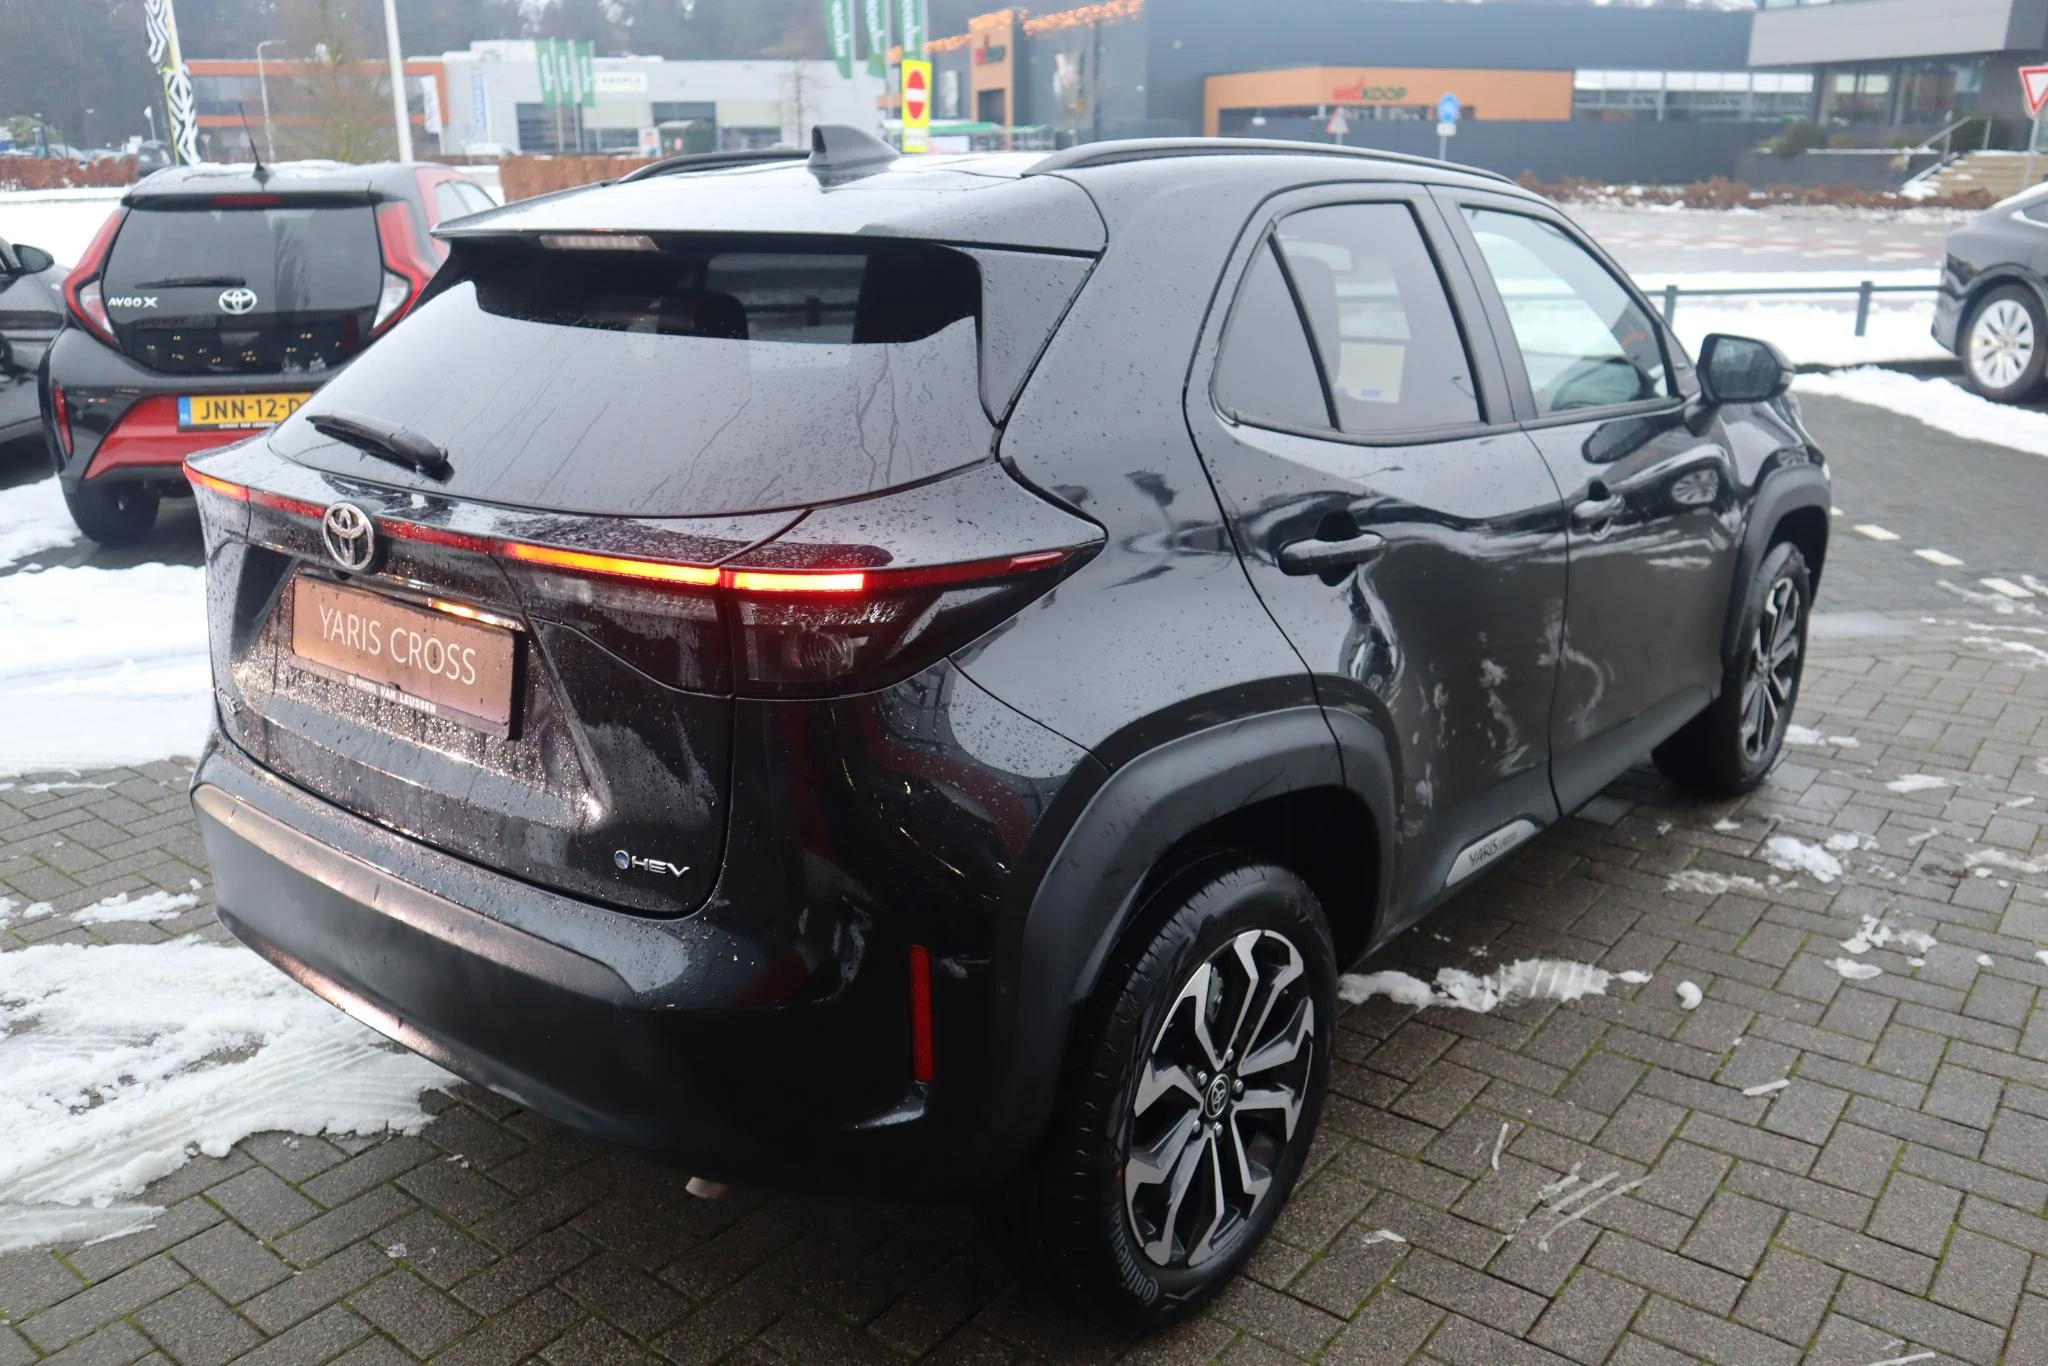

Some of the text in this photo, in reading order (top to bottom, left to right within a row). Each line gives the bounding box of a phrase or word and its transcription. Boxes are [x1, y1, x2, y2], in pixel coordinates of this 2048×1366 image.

[319, 604, 477, 685] YARIS CROSS
[355, 678, 437, 714] TOYOTA VAN LEUSSEN
[631, 855, 690, 878] HEV
